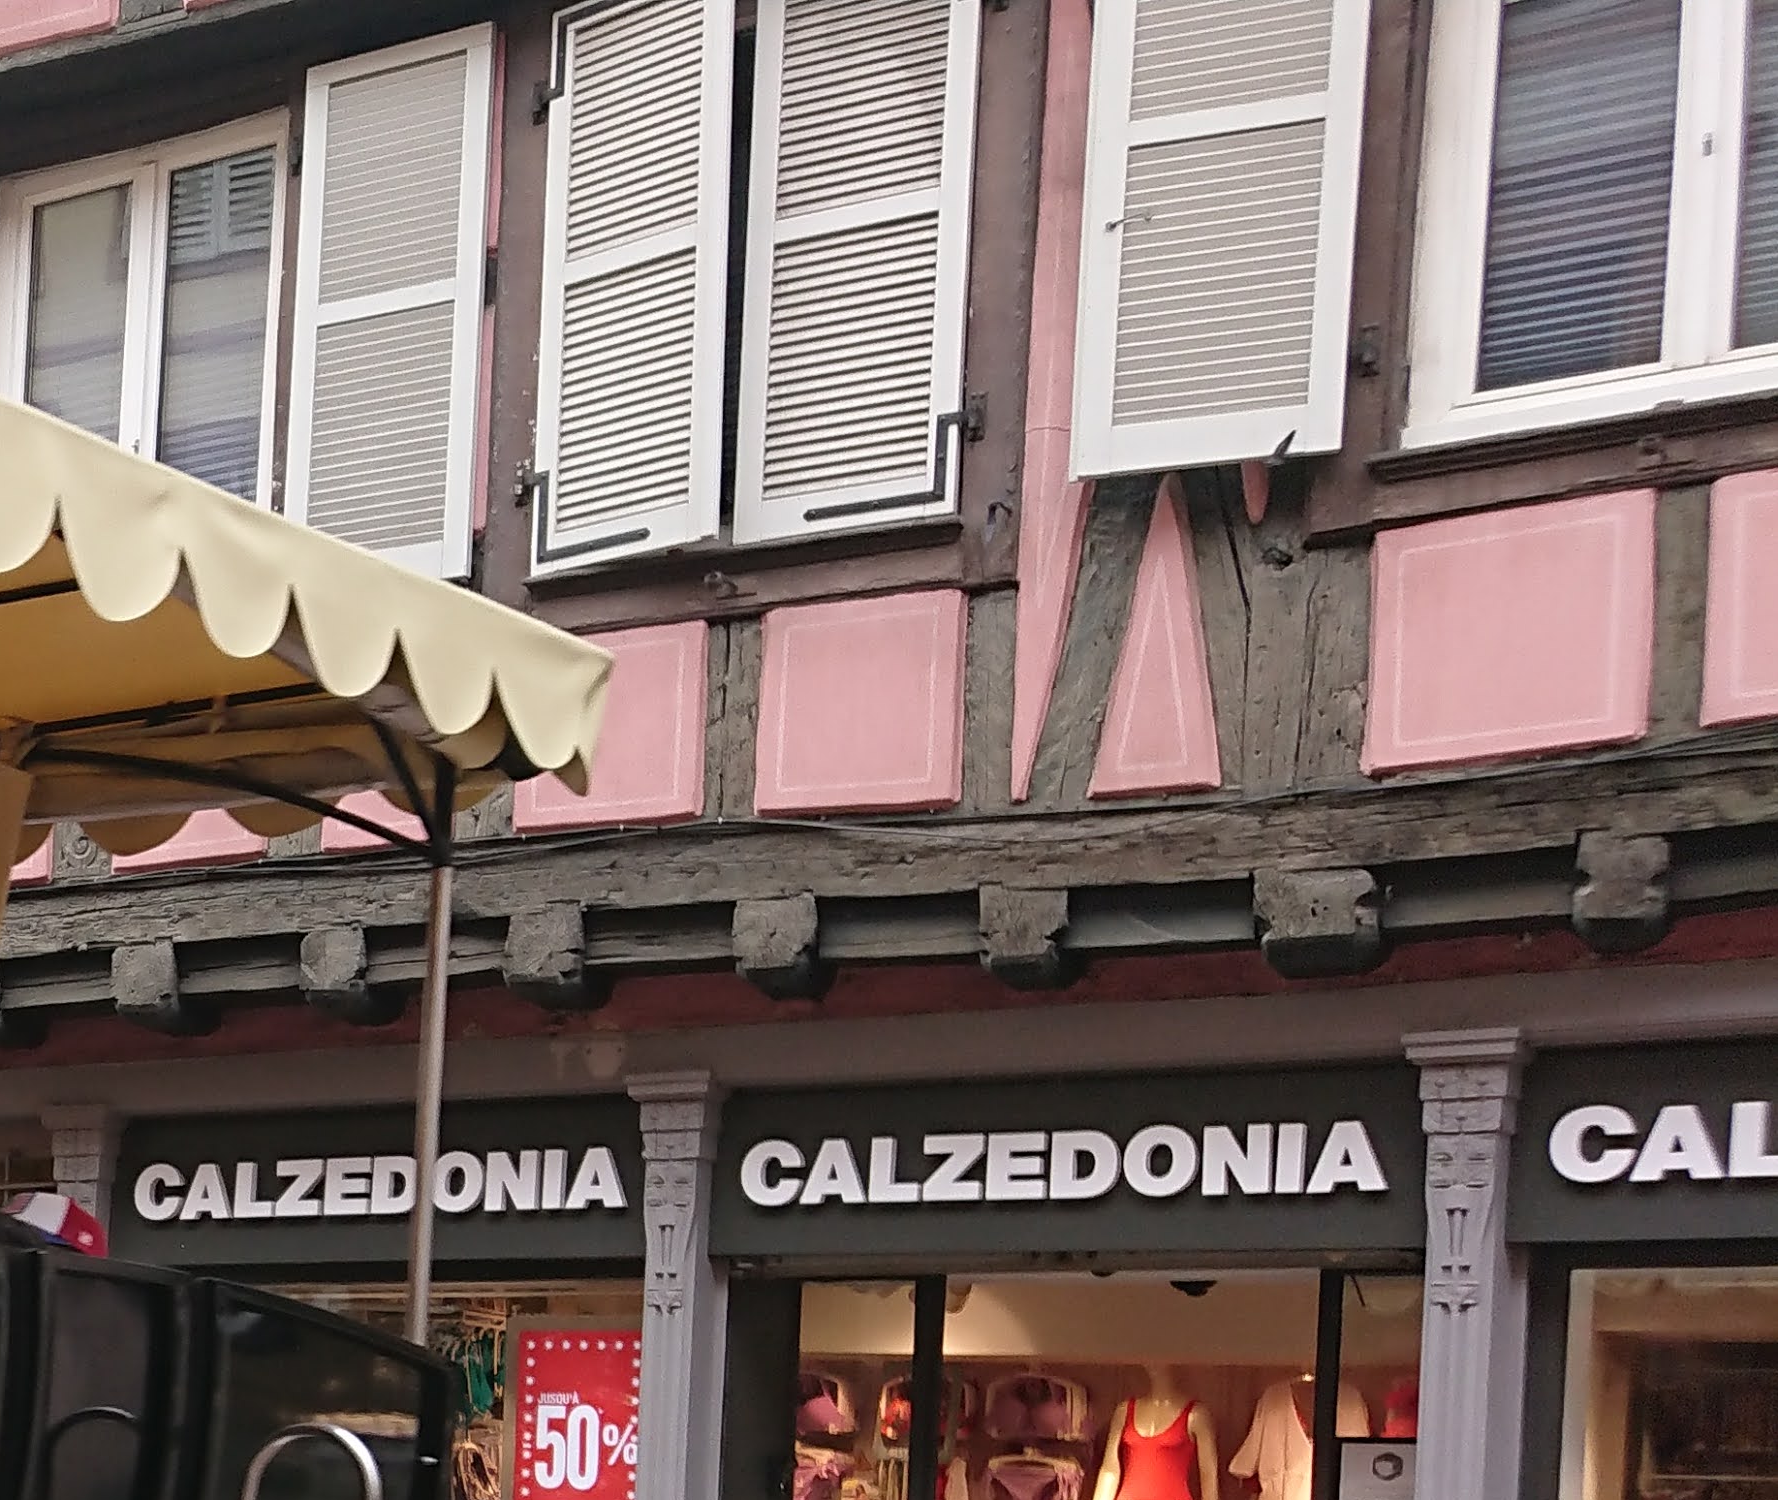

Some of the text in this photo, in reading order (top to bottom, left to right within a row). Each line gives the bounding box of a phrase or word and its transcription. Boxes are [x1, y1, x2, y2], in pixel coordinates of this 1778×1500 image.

[133, 1146, 629, 1221] CALZEDONIA
[740, 1119, 1390, 1207] CALZEDONIA
[1548, 1101, 1778, 1184] CAL
